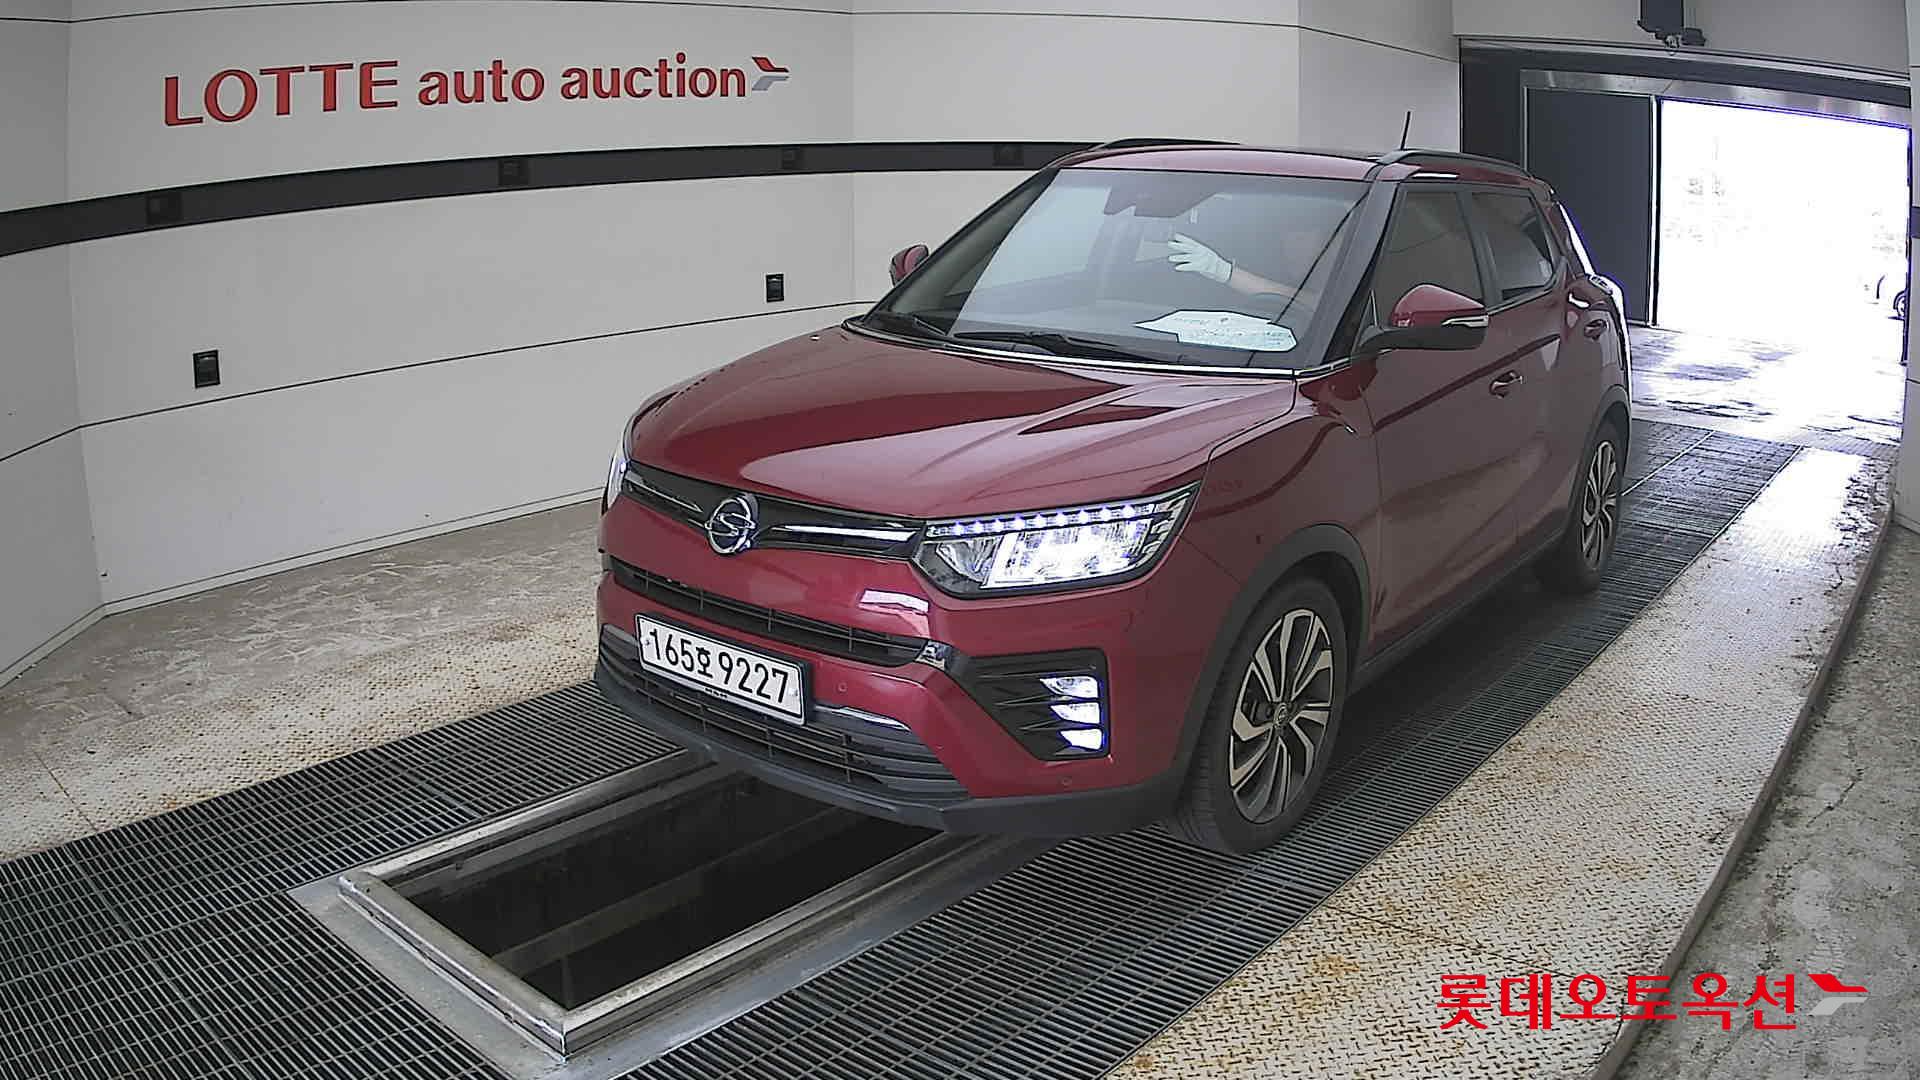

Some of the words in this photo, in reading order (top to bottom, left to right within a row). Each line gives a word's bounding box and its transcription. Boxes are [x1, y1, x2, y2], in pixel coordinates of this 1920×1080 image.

[163, 60, 399, 127] LOTTE
[418, 60, 545, 106] auto
[560, 53, 747, 100] auction
